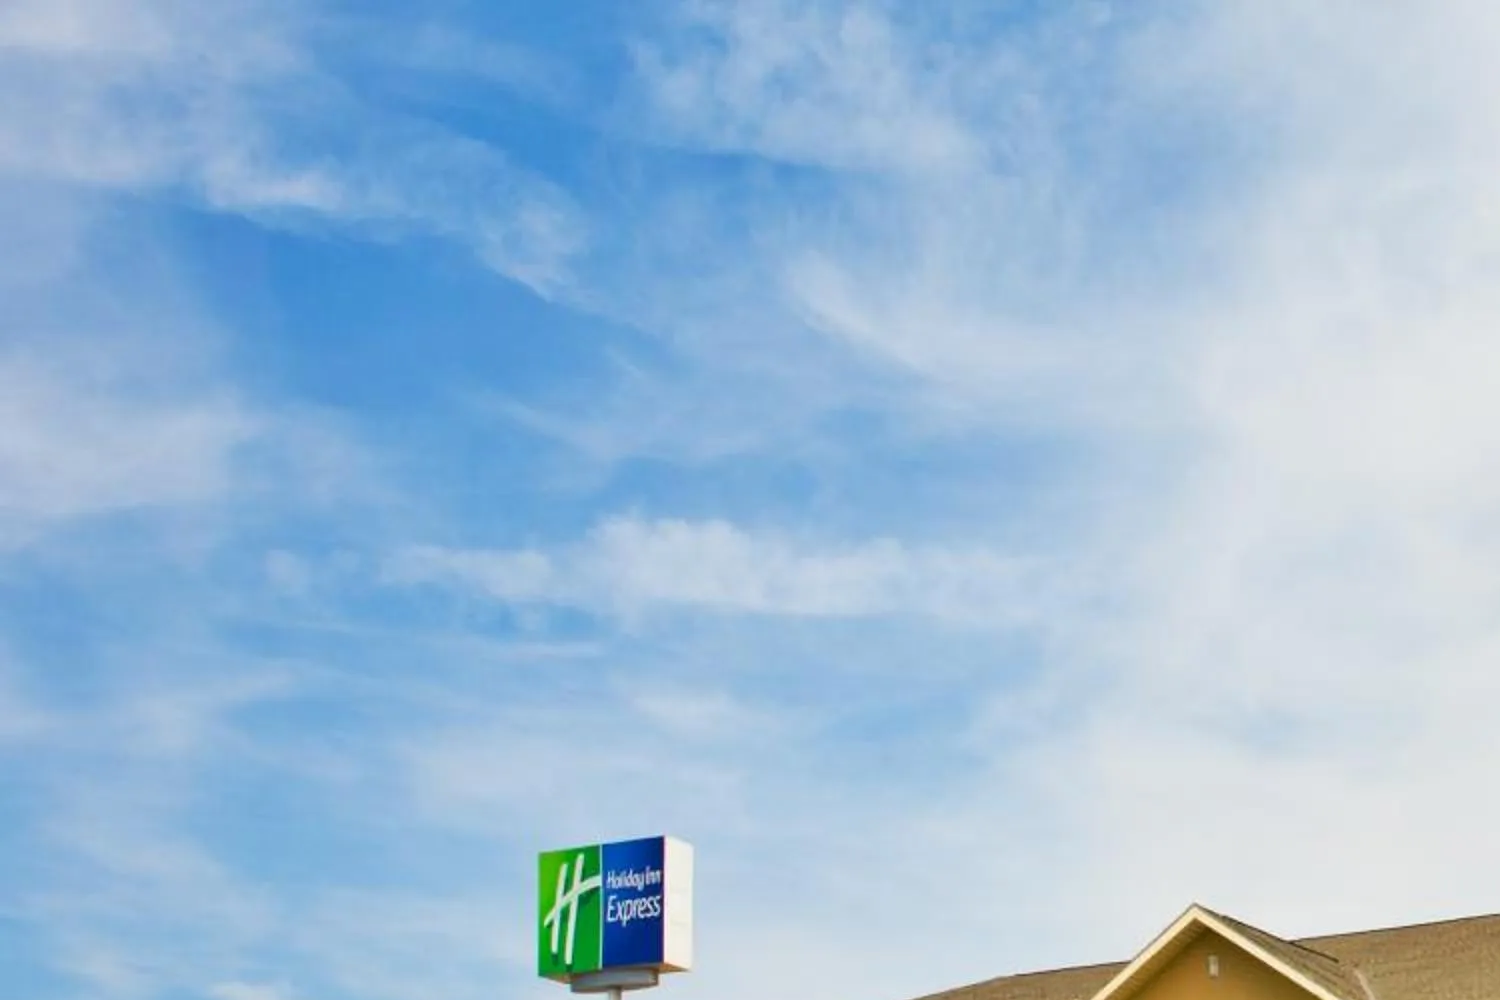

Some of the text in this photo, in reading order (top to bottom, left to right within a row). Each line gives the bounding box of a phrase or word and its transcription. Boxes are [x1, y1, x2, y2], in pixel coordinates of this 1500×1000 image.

[606, 866, 661, 891] Holiday Inn
[606, 895, 661, 927] Express
